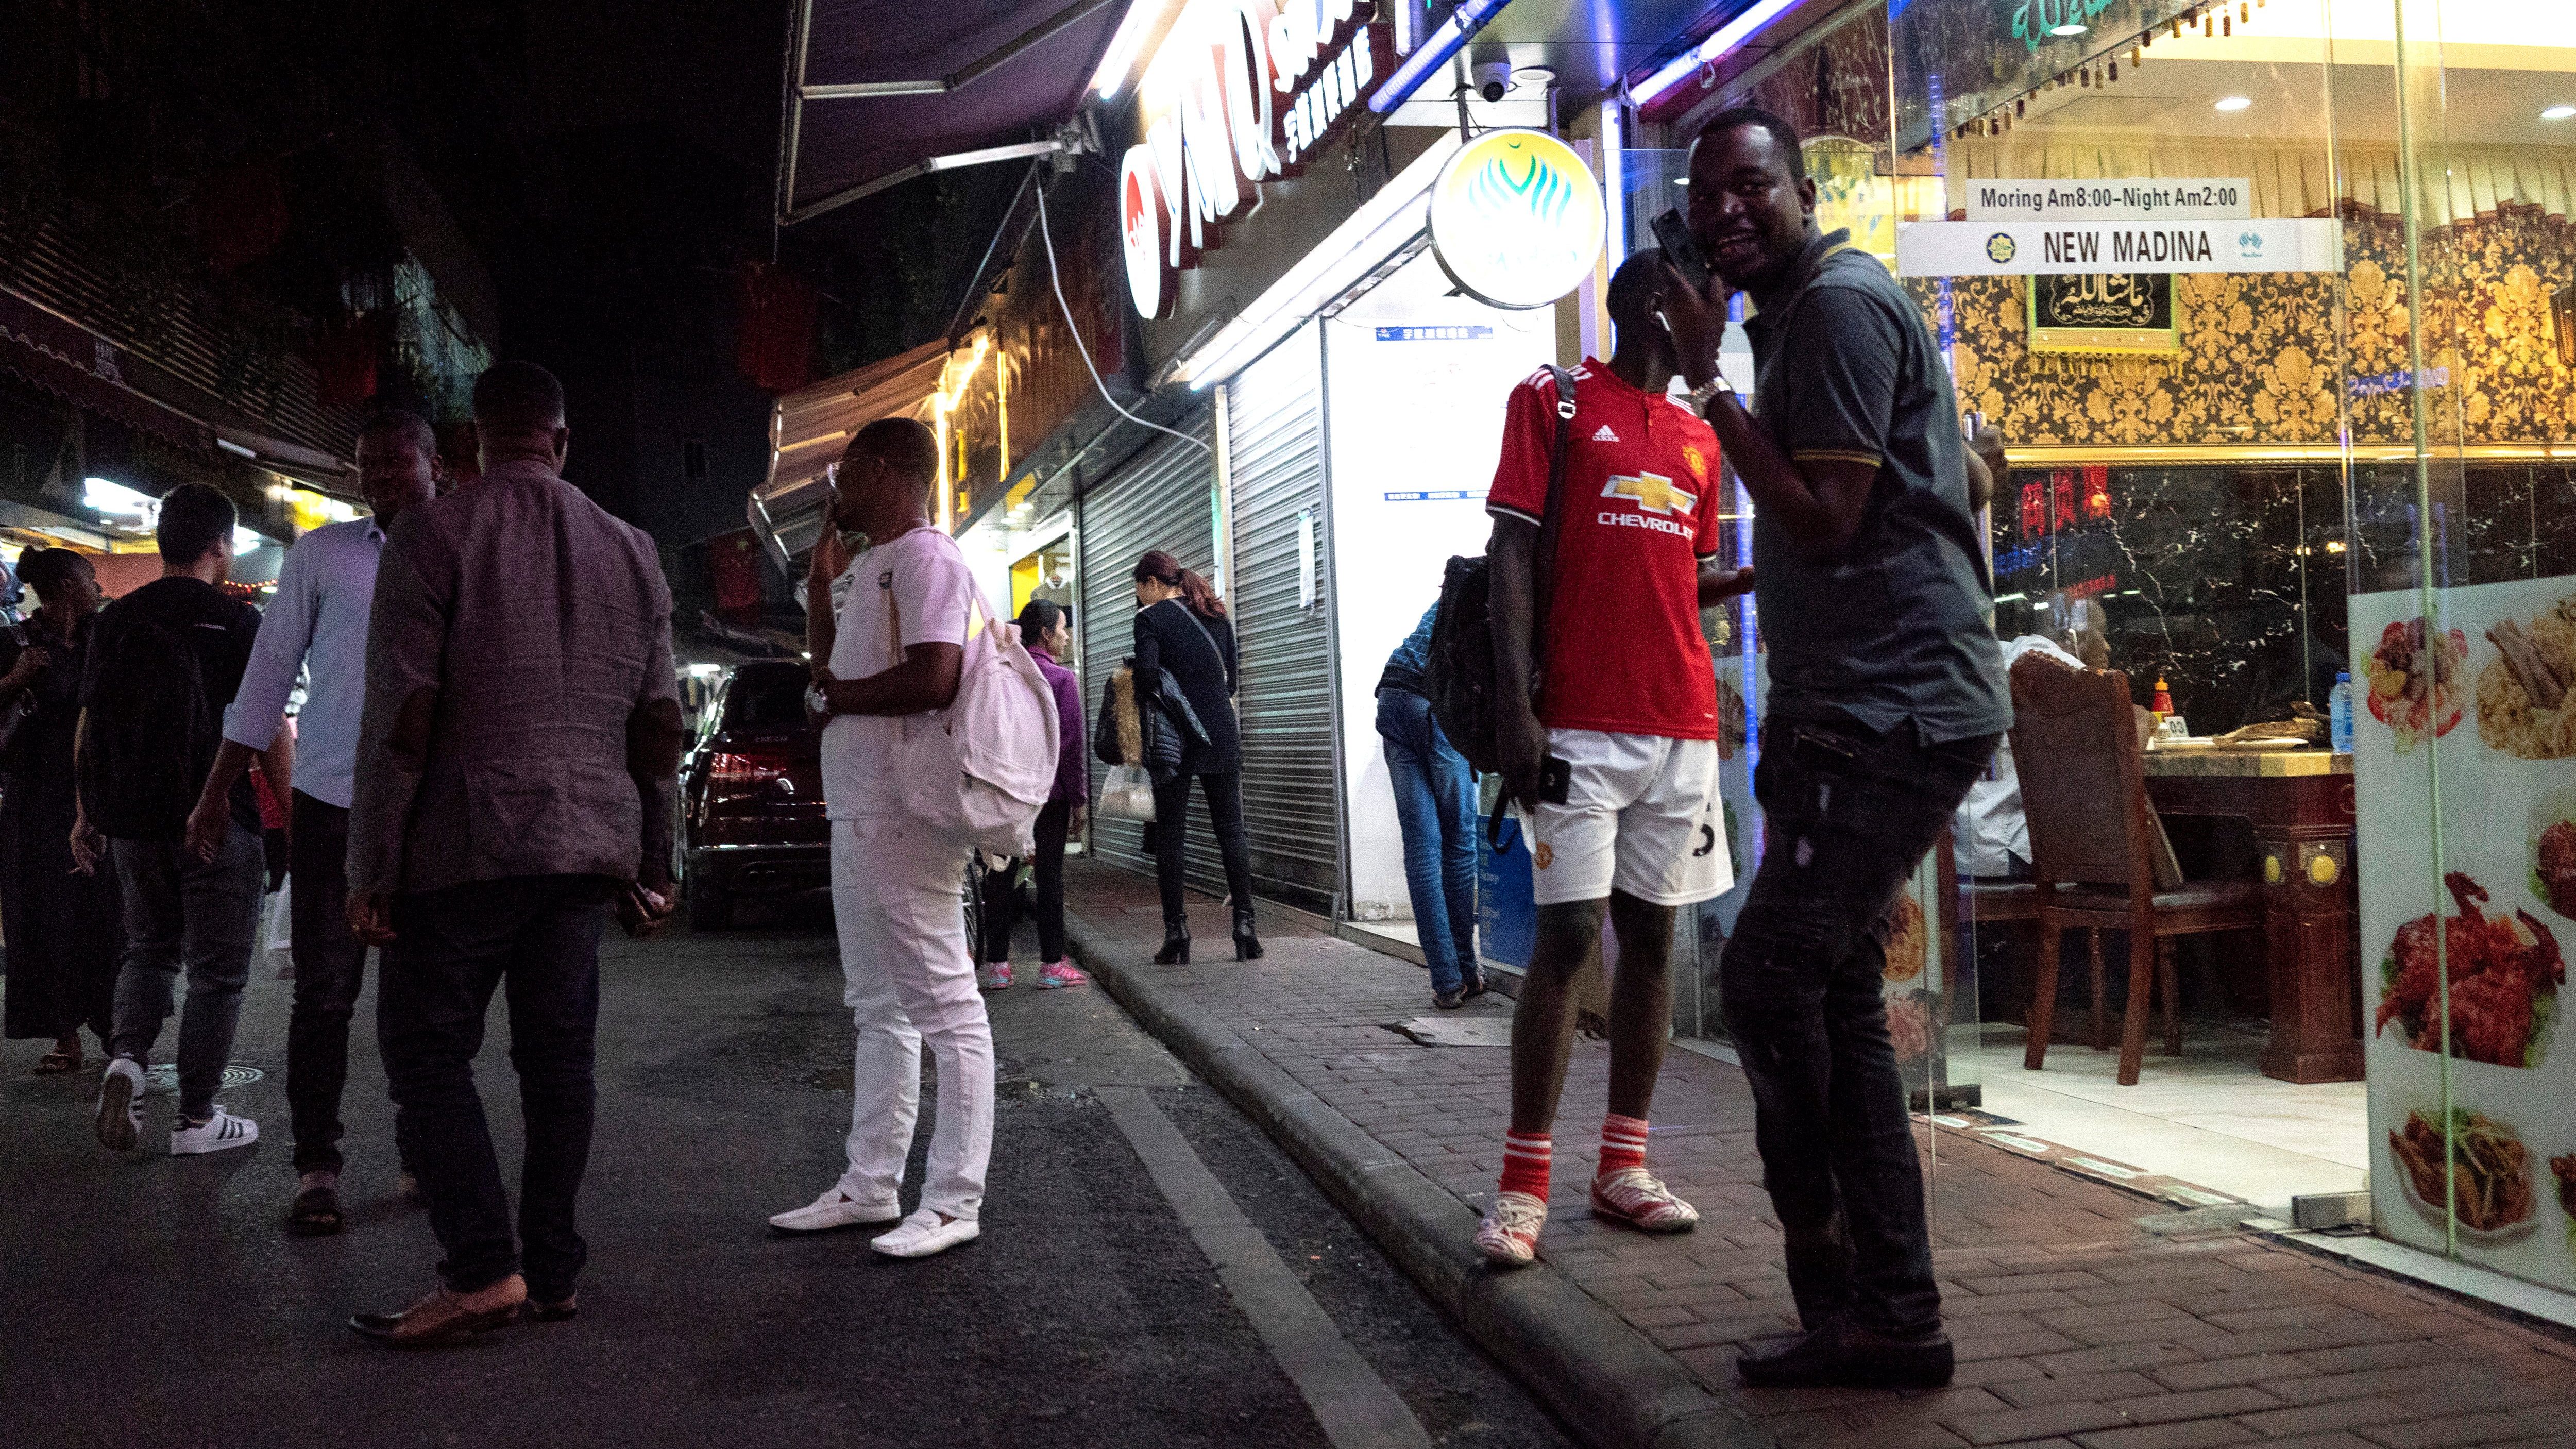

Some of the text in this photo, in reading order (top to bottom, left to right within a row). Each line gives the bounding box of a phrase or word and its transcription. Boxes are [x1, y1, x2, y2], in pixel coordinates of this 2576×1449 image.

[1981, 188, 2042, 211] Moring
[2175, 187, 2236, 207] Am2:00
[2044, 231, 2099, 263] NEW
[2113, 230, 2212, 262] MADINA
[2170, 721, 2184, 734] 03
